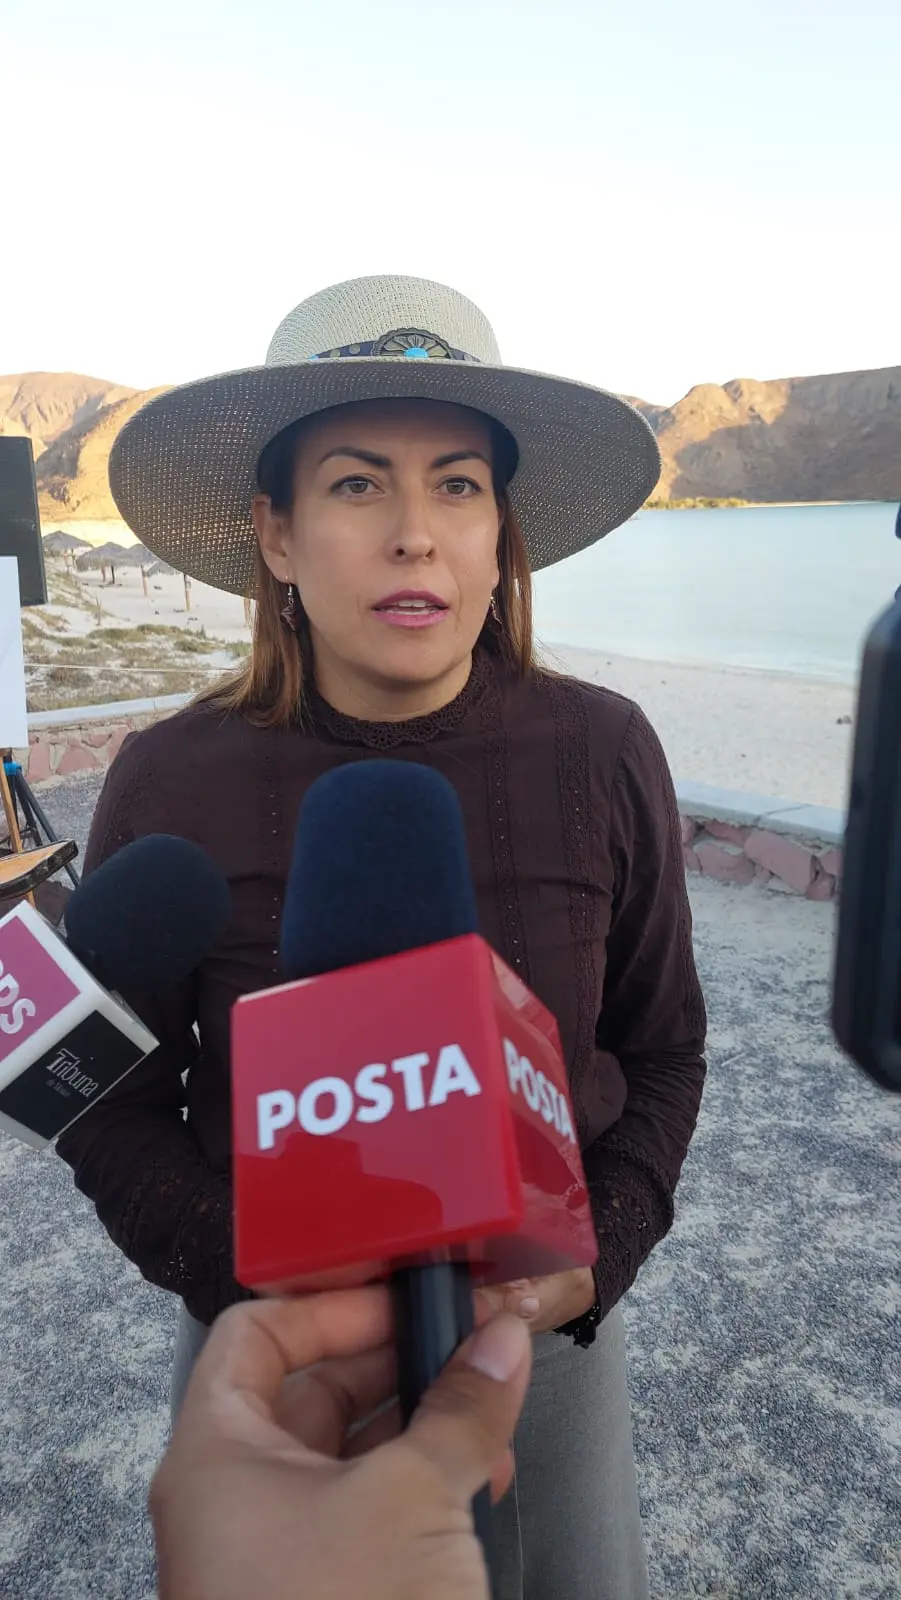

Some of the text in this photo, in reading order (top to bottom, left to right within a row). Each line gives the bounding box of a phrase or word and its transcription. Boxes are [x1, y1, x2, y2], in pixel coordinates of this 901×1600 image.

[46, 1048, 99, 1097] Tribuna
[257, 1043, 481, 1150] POSTA
[503, 1037, 576, 1144] POSTA
